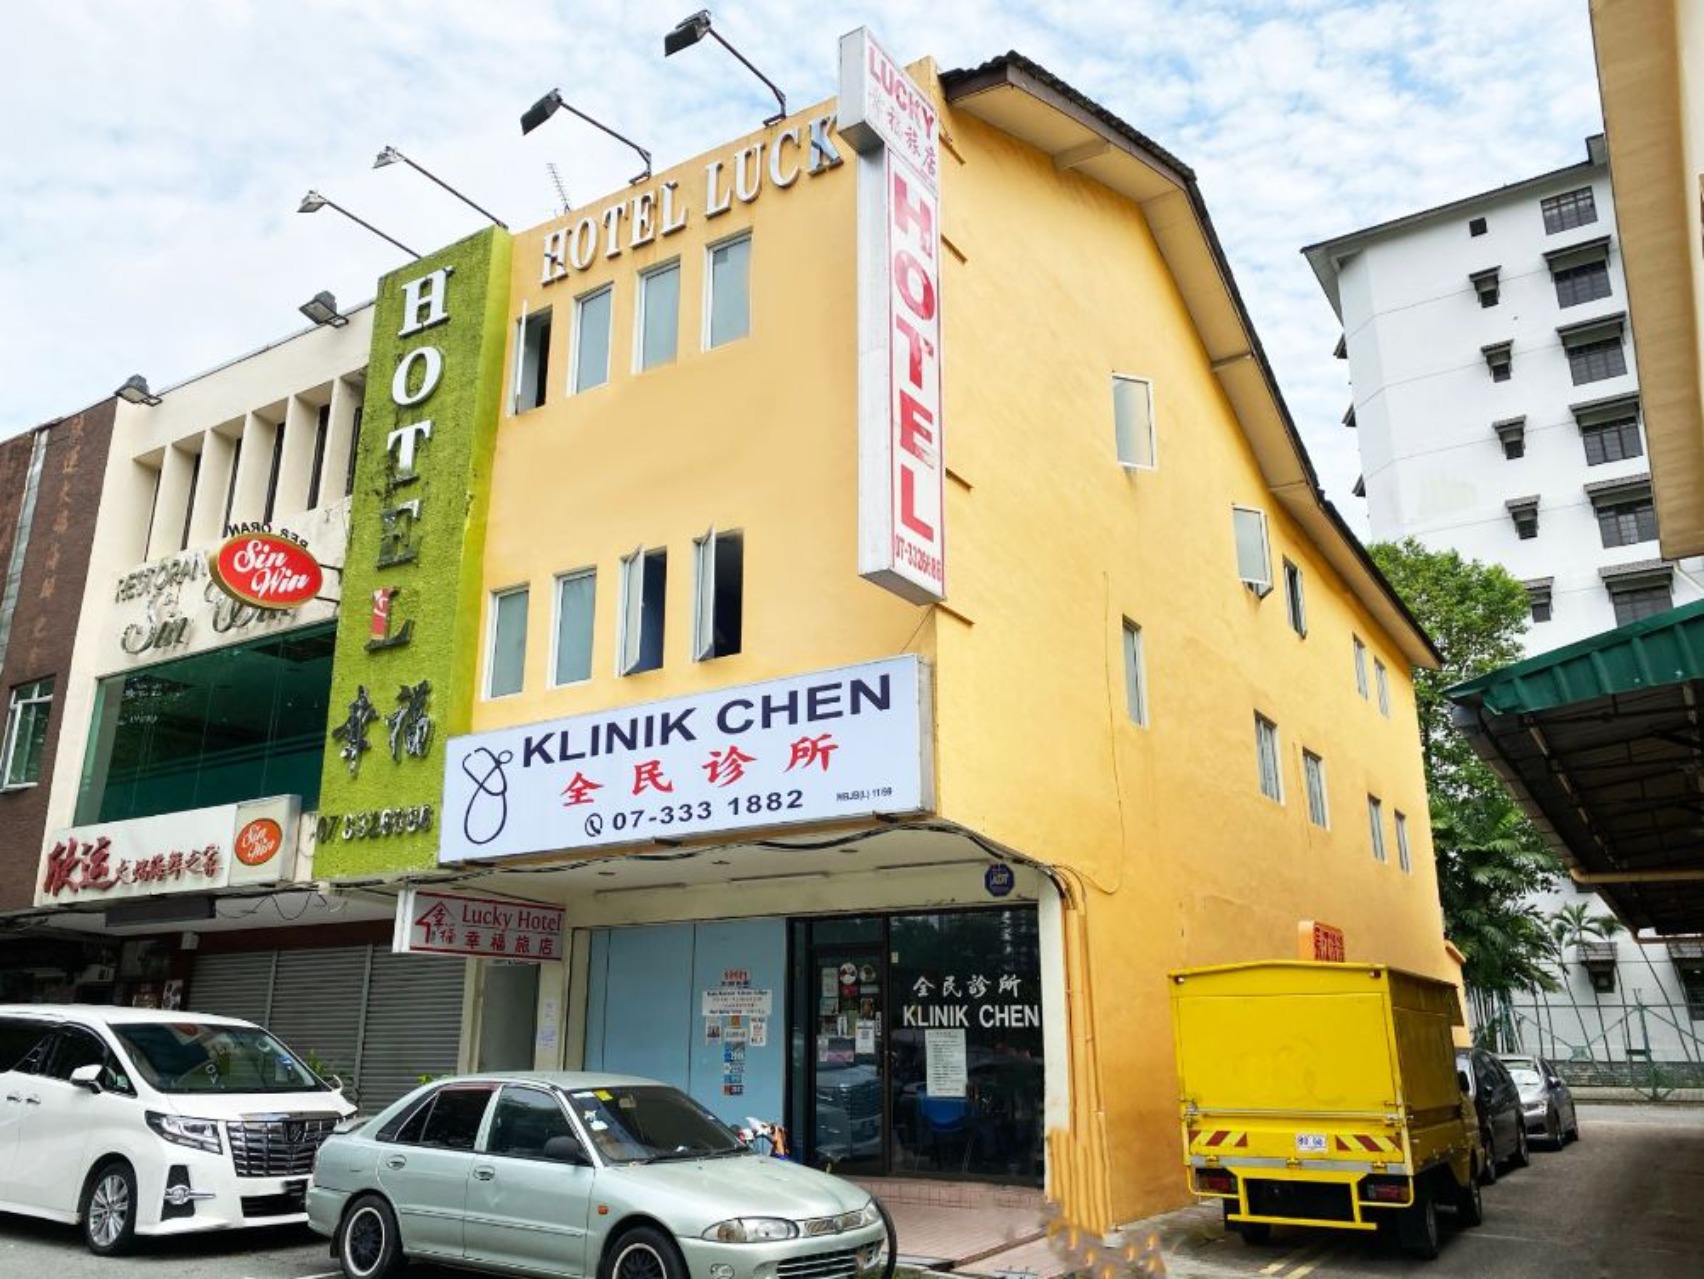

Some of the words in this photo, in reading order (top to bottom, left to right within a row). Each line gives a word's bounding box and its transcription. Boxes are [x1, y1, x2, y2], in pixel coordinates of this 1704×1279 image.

[868, 45, 934, 140] LUCKY
[541, 181, 688, 287] HOTEL
[894, 172, 935, 543] HOTEL
[364, 265, 456, 654] HOTEL
[233, 540, 287, 573] Sin
[251, 566, 310, 598] Win
[523, 708, 698, 768] KLINIK
[716, 674, 891, 735] CHEN
[560, 733, 840, 807] 全民诊所
[613, 801, 714, 831] 07-333
[730, 789, 804, 817] 1882
[462, 904, 512, 929] Lucky
[518, 911, 562, 931] Hotel
[465, 931, 553, 955] 幸福旅店
[913, 974, 1022, 998] 全民診所
[903, 1005, 969, 1027] KLINIK
[979, 1004, 1040, 1028] CHEN
